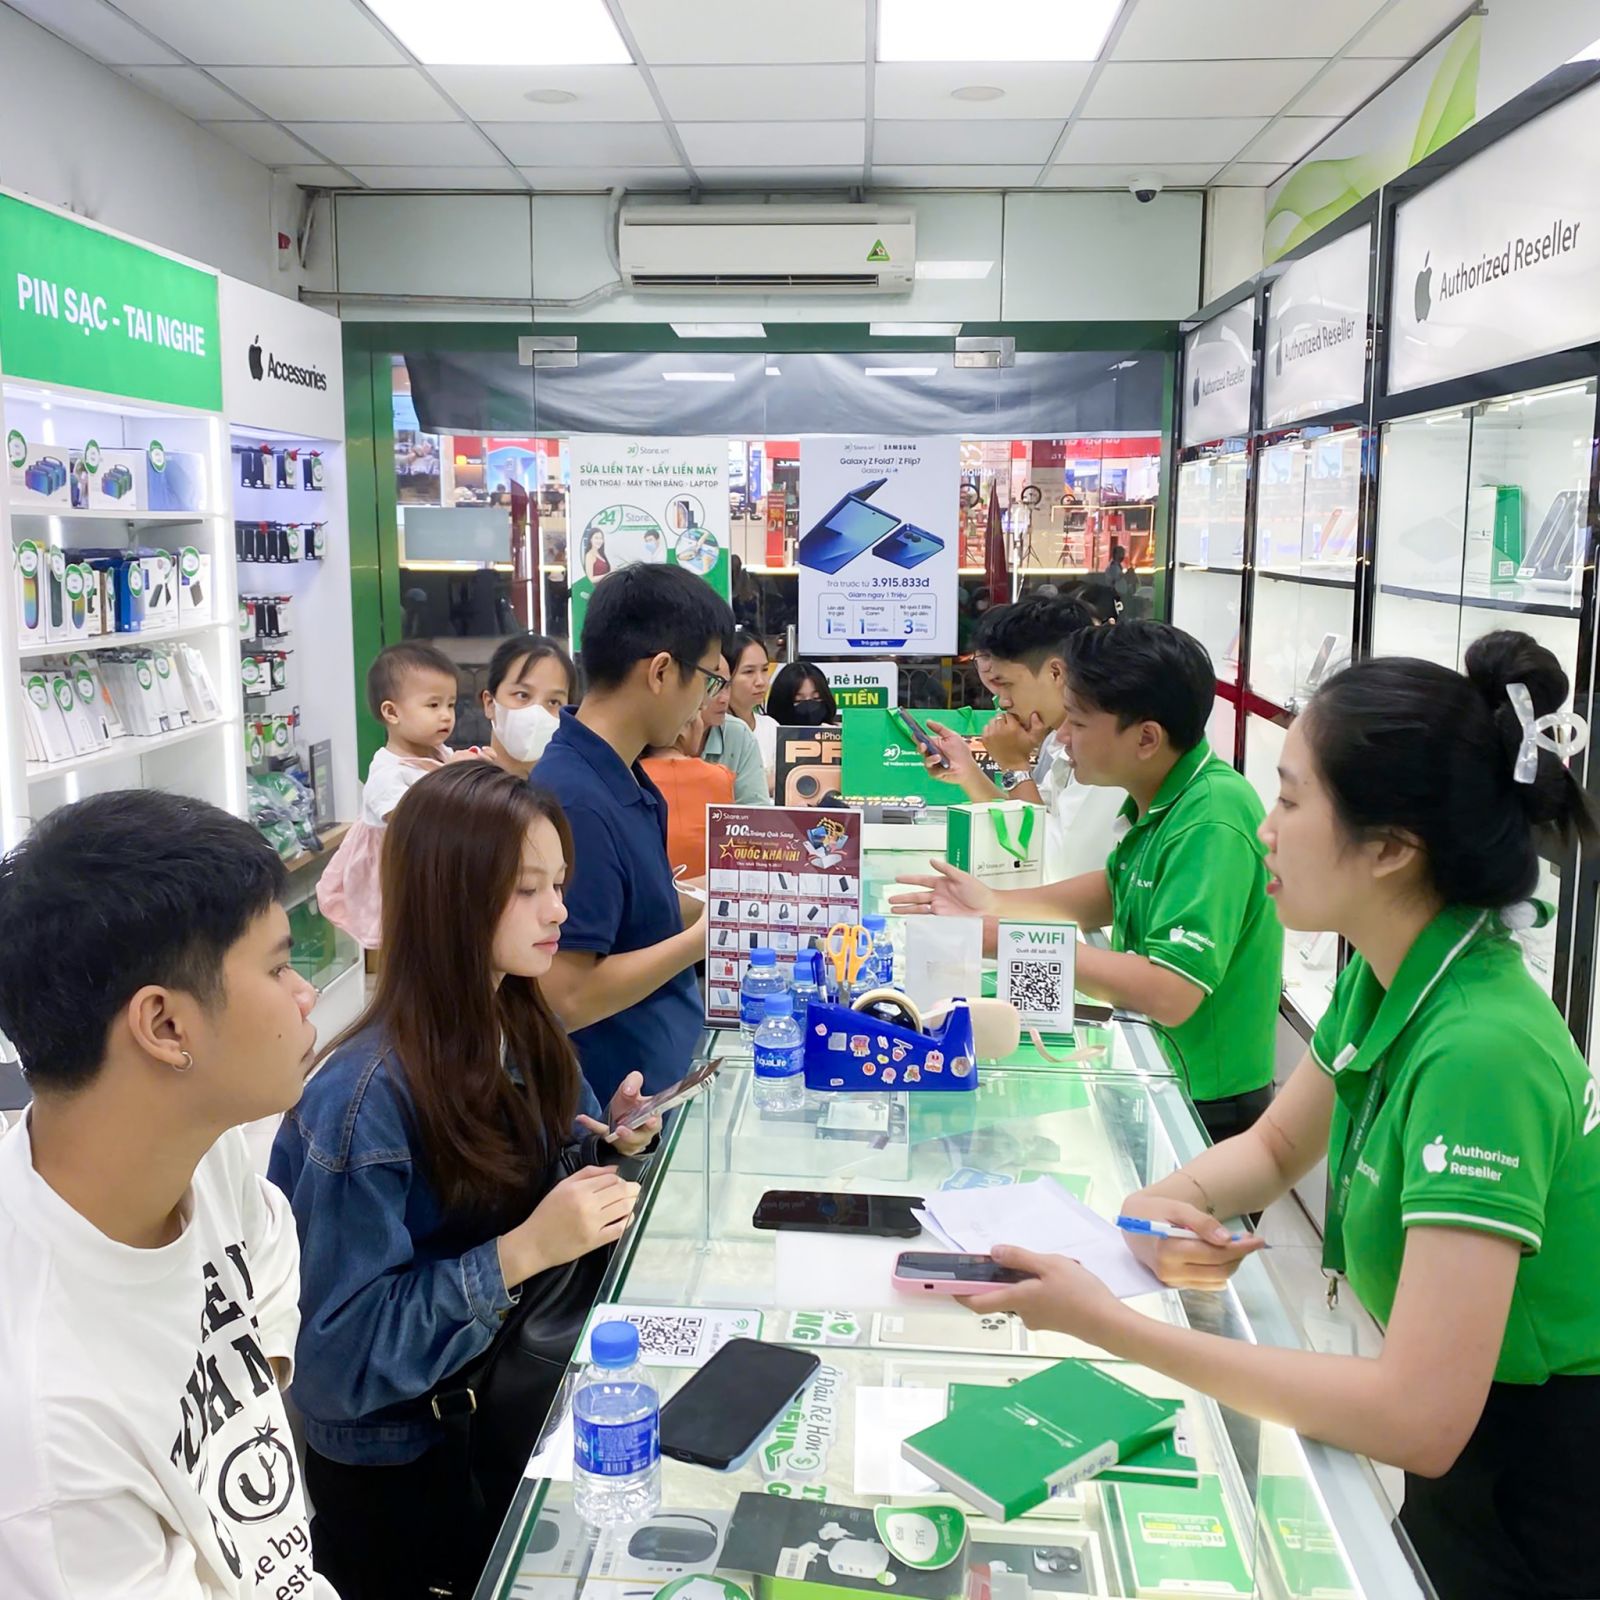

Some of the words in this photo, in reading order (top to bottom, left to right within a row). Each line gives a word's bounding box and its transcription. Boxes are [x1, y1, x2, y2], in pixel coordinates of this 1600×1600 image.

[1439, 242, 1509, 301] Authorized
[1513, 220, 1580, 272] Reseller
[17, 273, 58, 318] PIN
[64, 288, 107, 336] SẠC
[123, 304, 152, 342] TAI
[157, 316, 206, 356] NGHE
[1284, 327, 1322, 362] Authorized
[1323, 318, 1356, 348] Reseller
[267, 352, 327, 391] Accessories
[626, 465, 643, 474] TAY
[696, 464, 718, 476] MÁY
[840, 457, 867, 465] Galaxy
[874, 457, 895, 465] Fold7
[904, 457, 921, 466] Flip7
[690, 480, 719, 488] LAPTOP
[598, 510, 616, 525] 24
[826, 619, 831, 634] 1
[860, 619, 865, 634] 1
[904, 619, 914, 634] 3
[834, 674, 850, 685] Rẻ
[854, 674, 879, 685] Hơn
[842, 688, 879, 705] TIỀN
[1028, 931, 1065, 945] WIFI
[1453, 1144, 1520, 1168] Authorized
[1450, 1162, 1503, 1181] Reseller
[809, 1404, 832, 1424] Rẻ
[805, 1423, 830, 1452] Hơn
[267, 1523, 309, 1559] by
